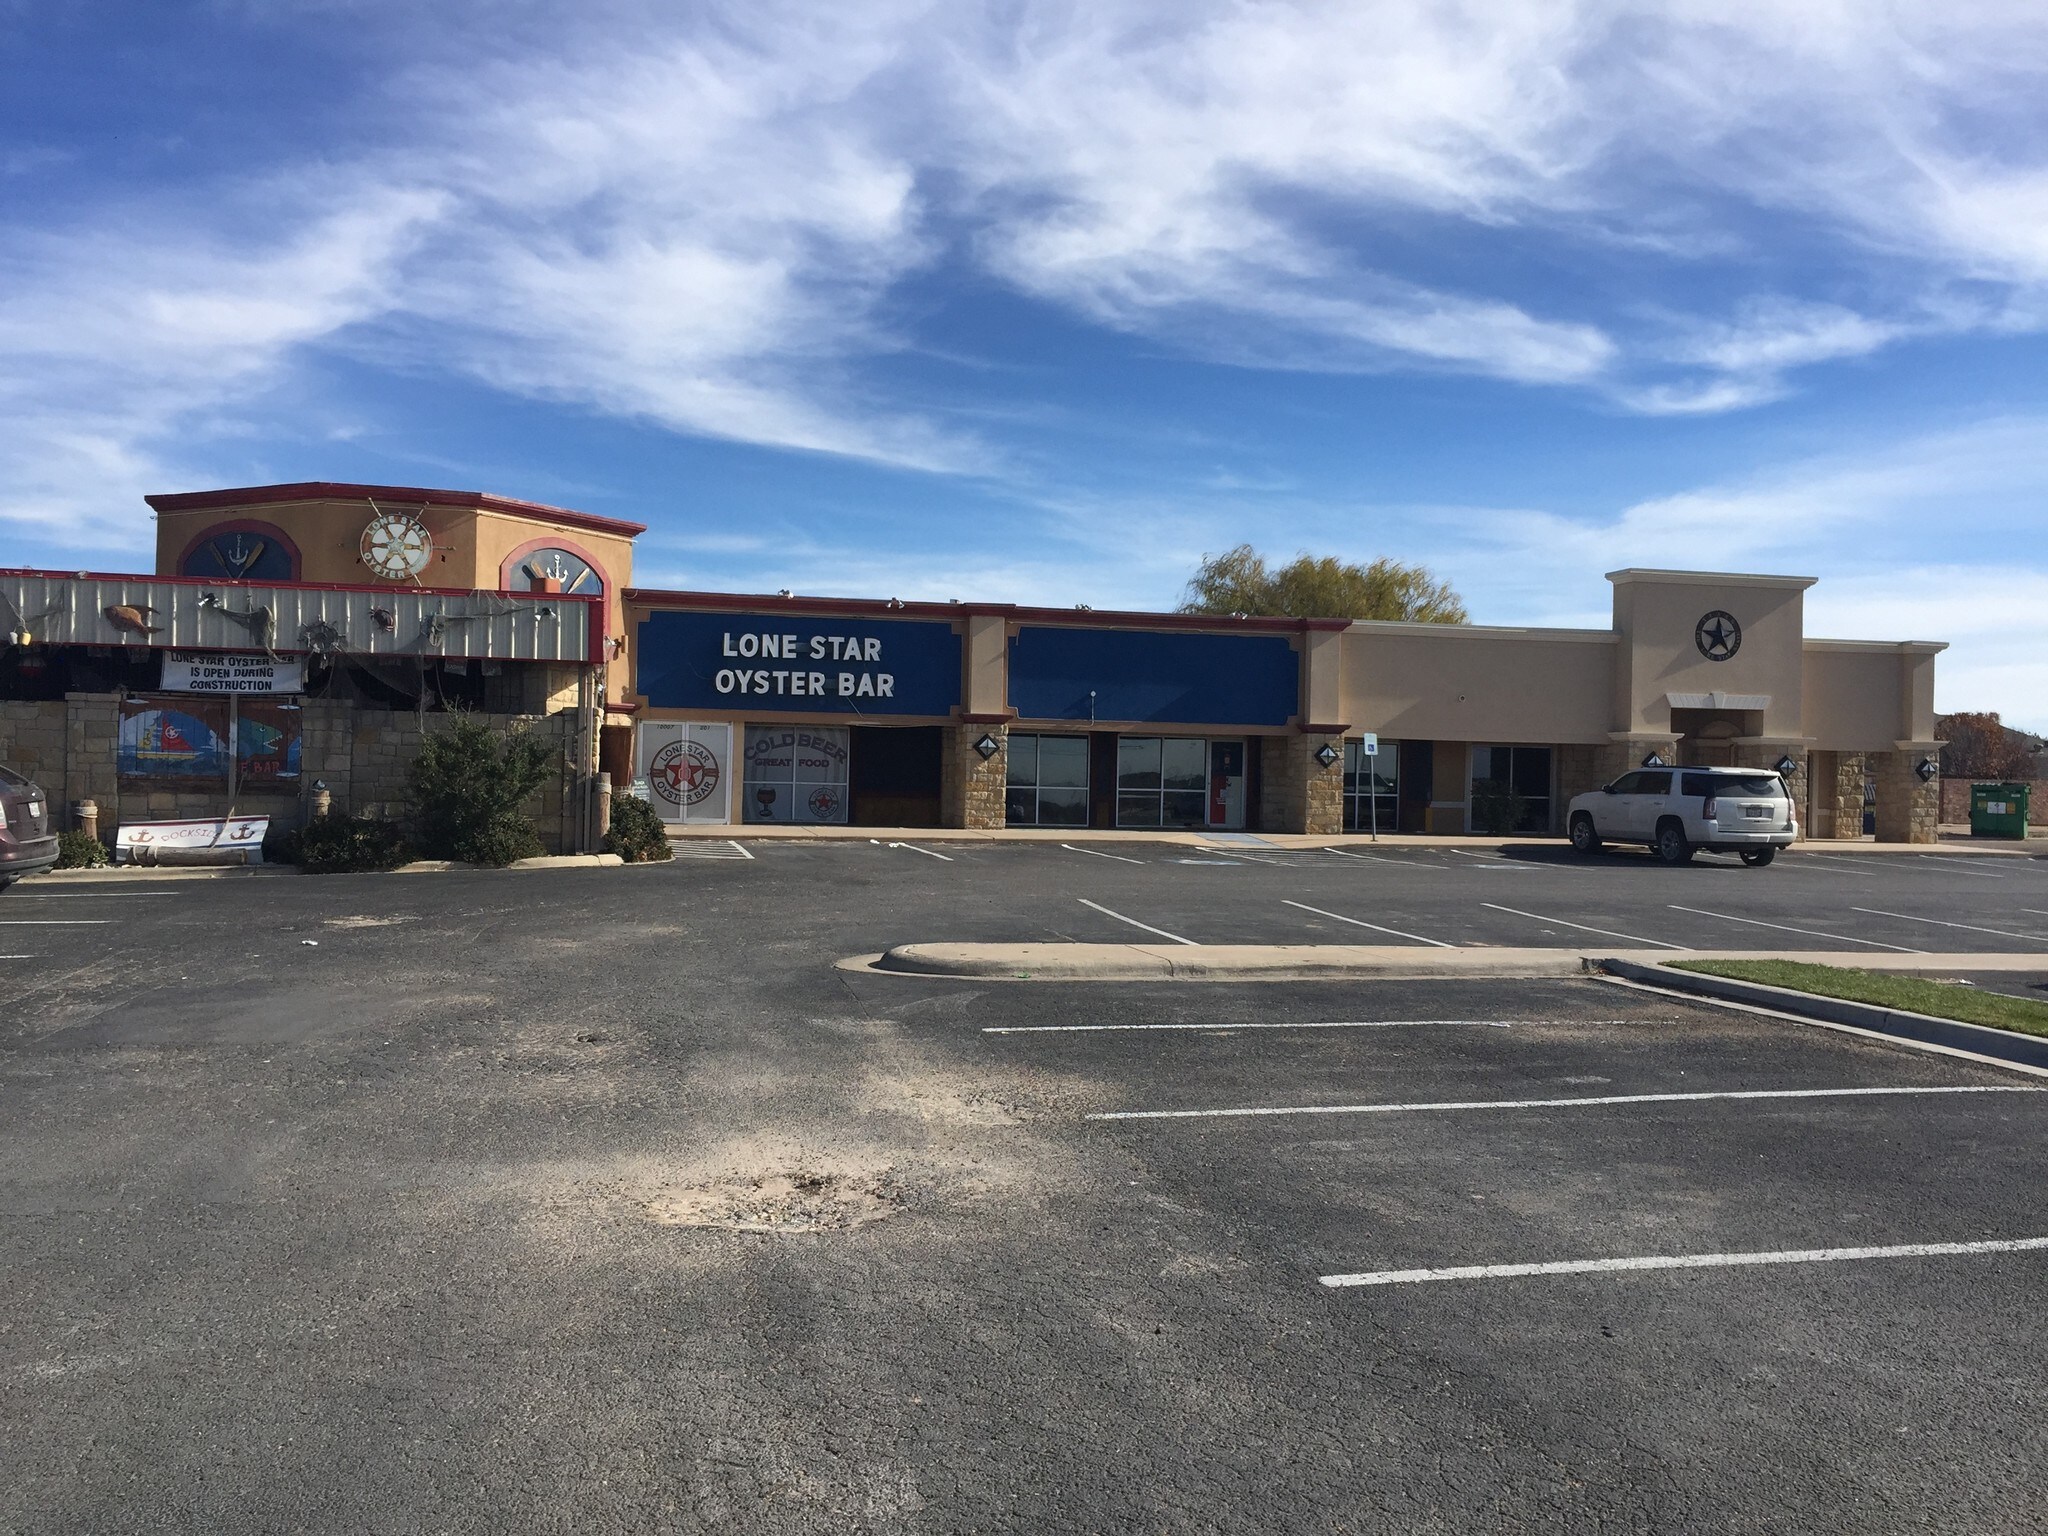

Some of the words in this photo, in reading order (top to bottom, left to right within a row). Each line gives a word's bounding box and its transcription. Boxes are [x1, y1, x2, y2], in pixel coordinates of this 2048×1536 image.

[367, 515, 395, 535] LONE
[400, 516, 426, 538] STAR
[364, 552, 405, 578] OYSTER
[723, 632, 797, 659] LONE
[809, 635, 882, 662] STAR
[198, 655, 224, 666] STAR
[228, 655, 270, 667] OYSTER
[190, 667, 200, 677] IS
[203, 667, 230, 679] OPEN
[233, 667, 274, 678] DURING
[189, 680, 272, 691] CONSTRUCTION
[715, 669, 826, 696] OYSTER
[838, 672, 895, 698] BAR
[660, 744, 685, 762] LONE
[687, 744, 710, 763] STAR
[745, 733, 795, 760] COLD
[798, 733, 848, 765] BEER
[254, 761, 280, 773] BAR
[755, 758, 792, 767] GREAT
[798, 758, 830, 768] FOOD
[657, 781, 693, 802] OYSTER
[694, 781, 713, 799] BAR
